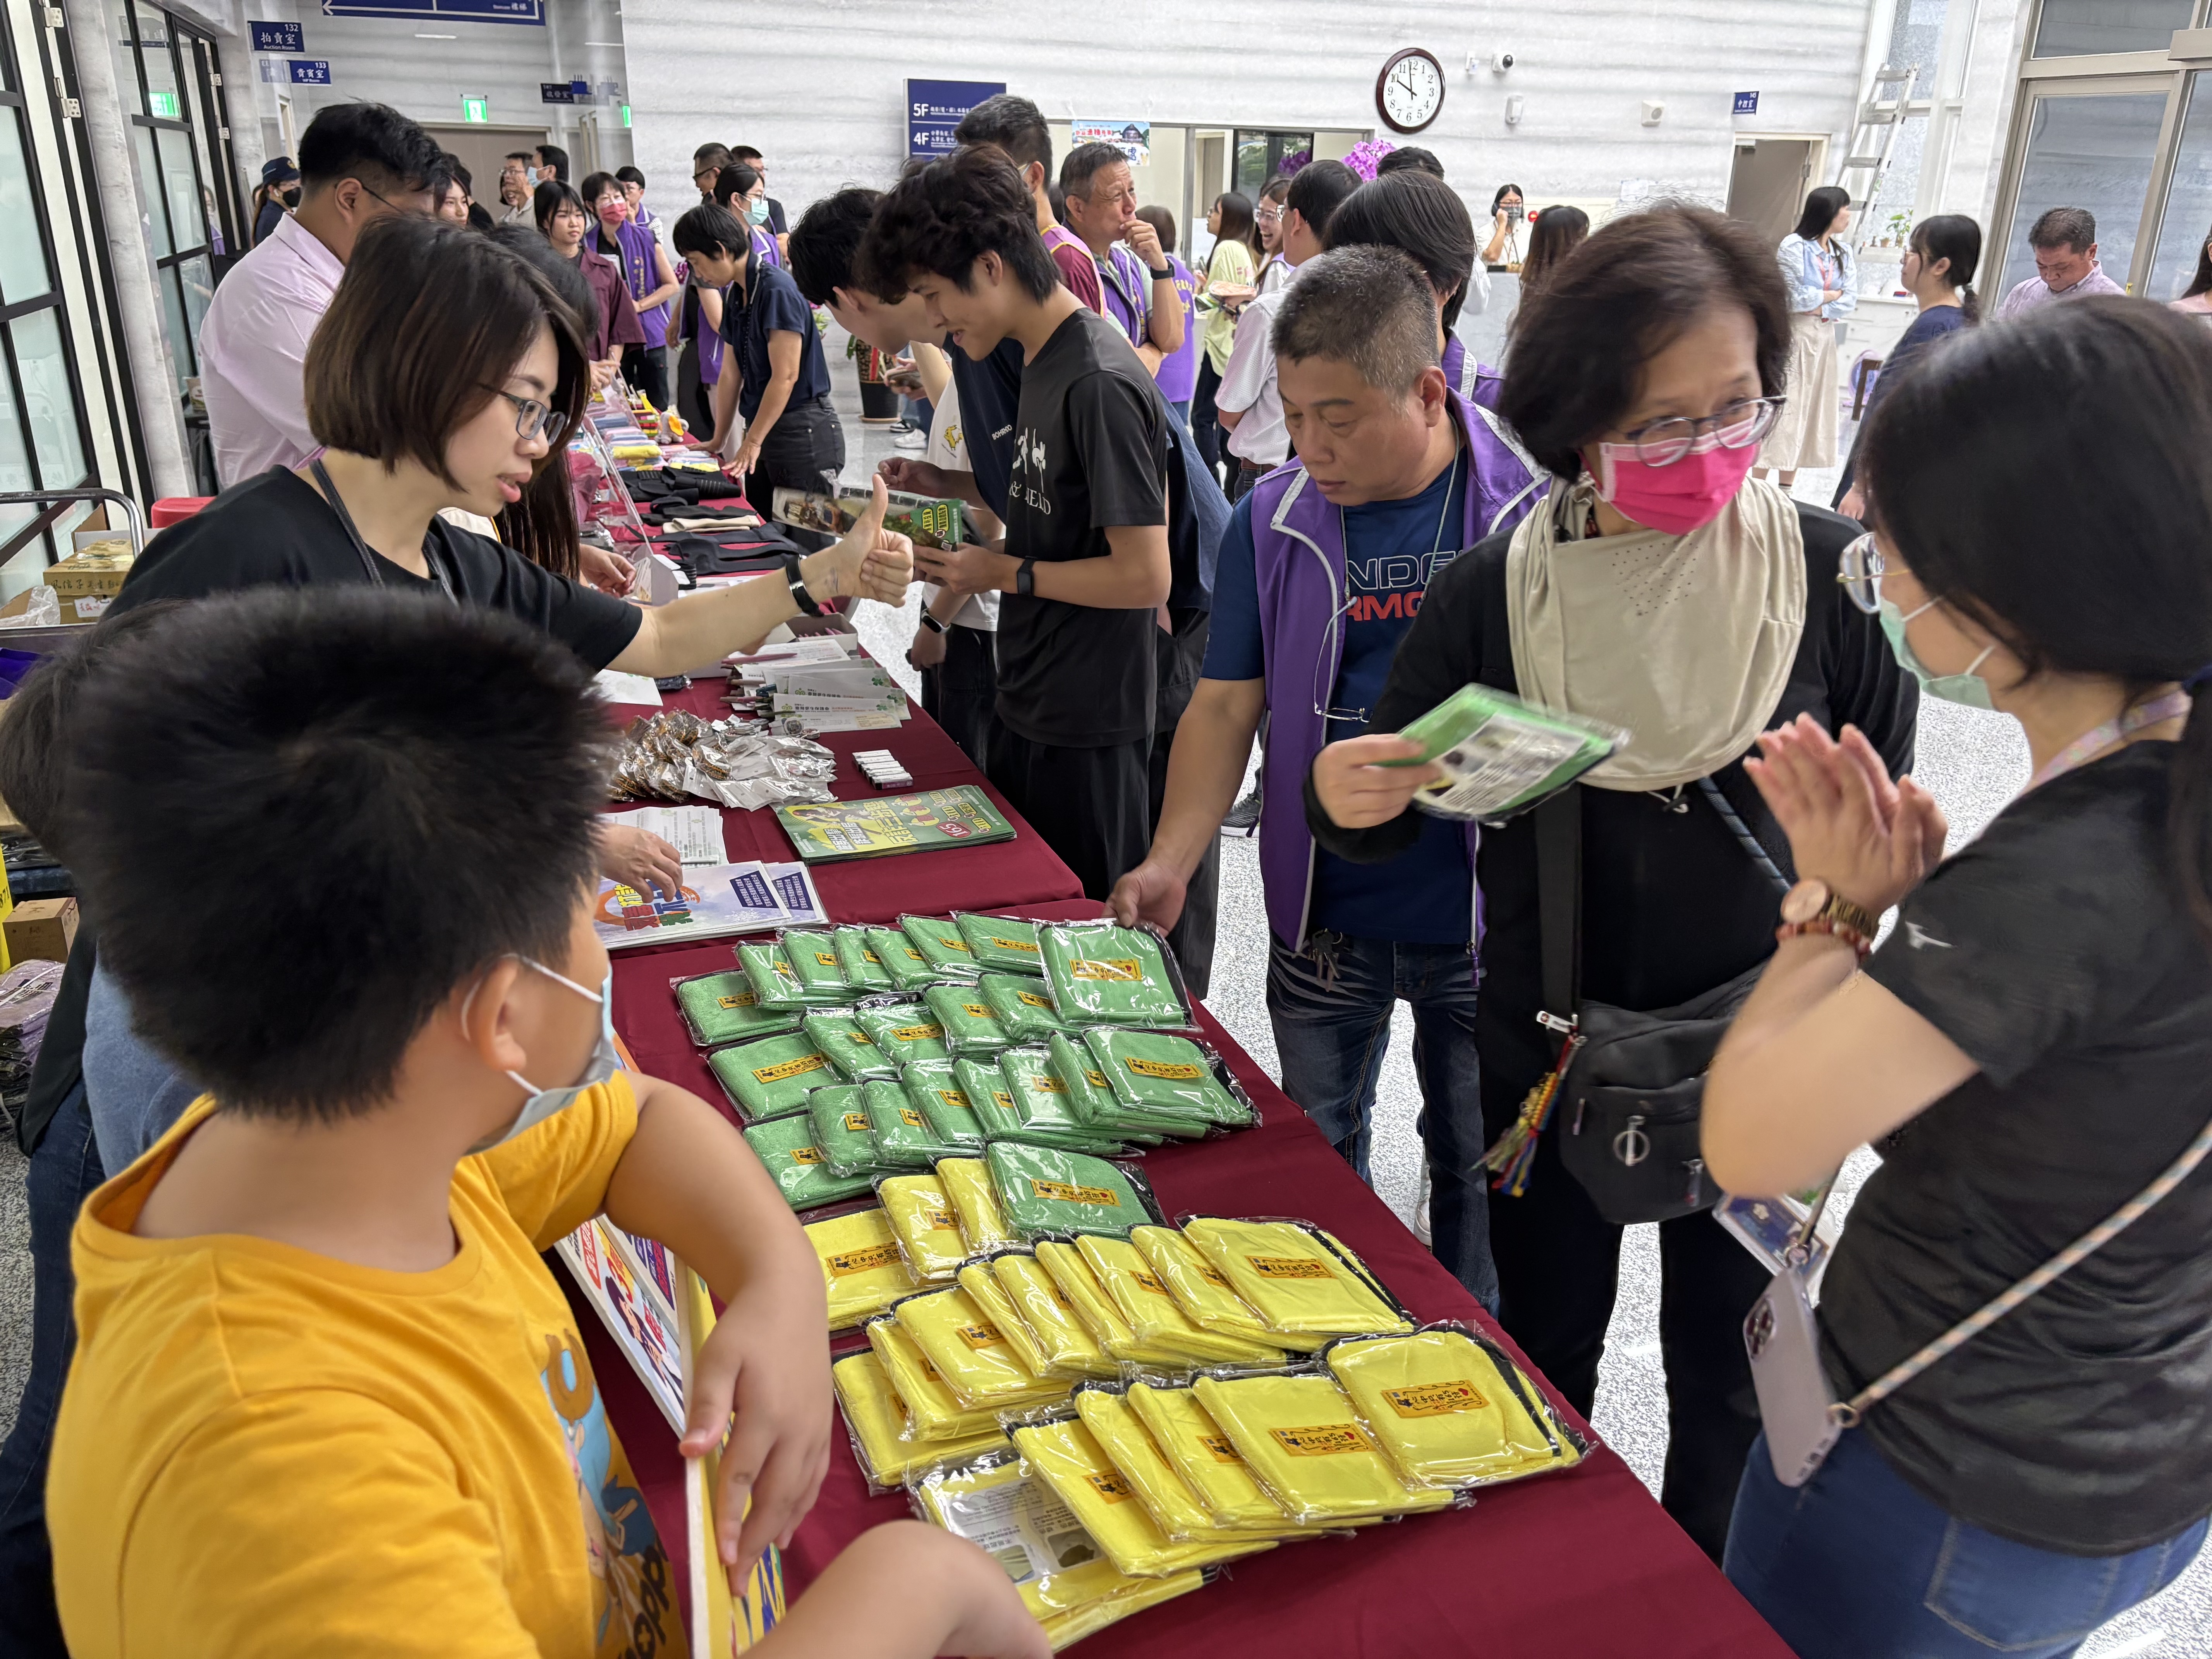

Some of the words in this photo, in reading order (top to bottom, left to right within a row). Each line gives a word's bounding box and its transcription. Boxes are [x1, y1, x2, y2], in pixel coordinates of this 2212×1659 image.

[261, 31, 295, 44] 拍賣室
[1399, 64, 1406, 73] 11
[1410, 60, 1418, 70] 12
[1422, 65, 1425, 74] 1
[1391, 73, 1399, 82] 10
[1428, 74, 1433, 83] 2
[1388, 86, 1393, 96] 9
[1429, 88, 1434, 97] 3
[1390, 100, 1395, 108] 8
[1424, 100, 1429, 109] 4
[913, 103, 929, 117] 5F
[1396, 109, 1402, 118] 7
[1417, 109, 1422, 118] 5
[1406, 112, 1412, 122] 6
[914, 132, 929, 145] 4F
[862, 800, 919, 844] 反詐三步驟
[939, 823, 969, 837] 165
[1412, 1390, 1461, 1404] 心中只有165符
[1299, 1432, 1349, 1444] 心中只有165符
